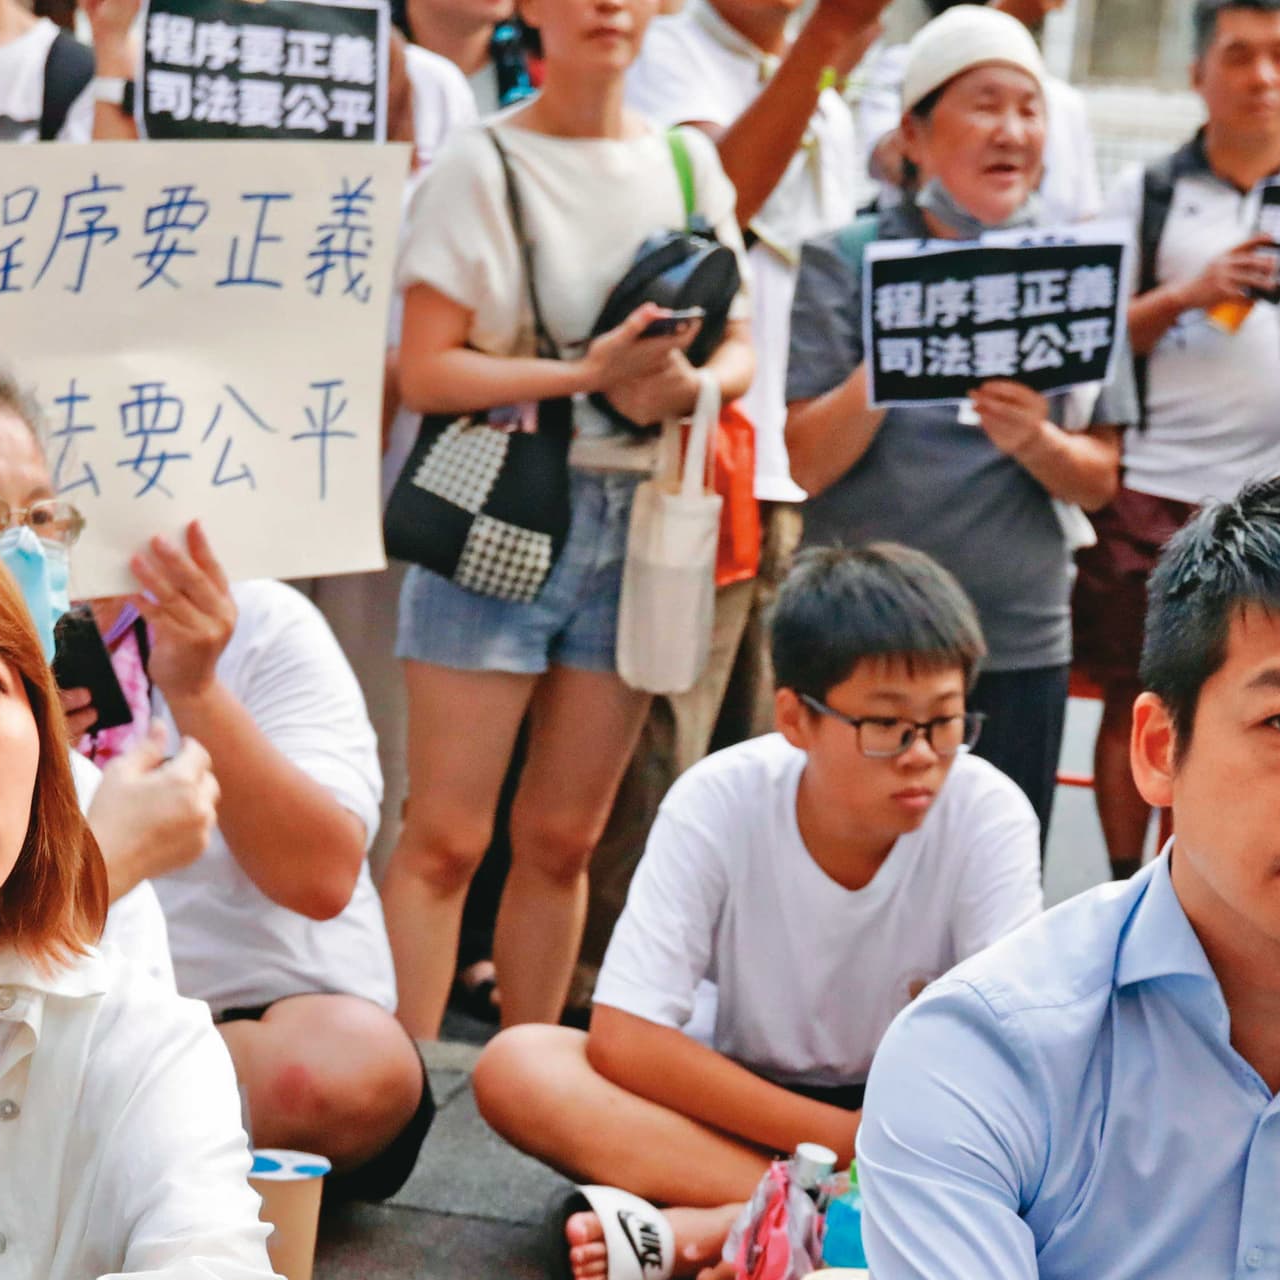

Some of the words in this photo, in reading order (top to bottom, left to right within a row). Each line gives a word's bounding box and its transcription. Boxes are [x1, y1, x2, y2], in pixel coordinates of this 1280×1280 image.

[147, 12, 375, 85] 程序要正義
[147, 69, 374, 137] 司法要公平
[876, 264, 1113, 331] 程序要正義
[877, 316, 1111, 378] 司法要公平
[638, 1221, 664, 1271] NIKE
